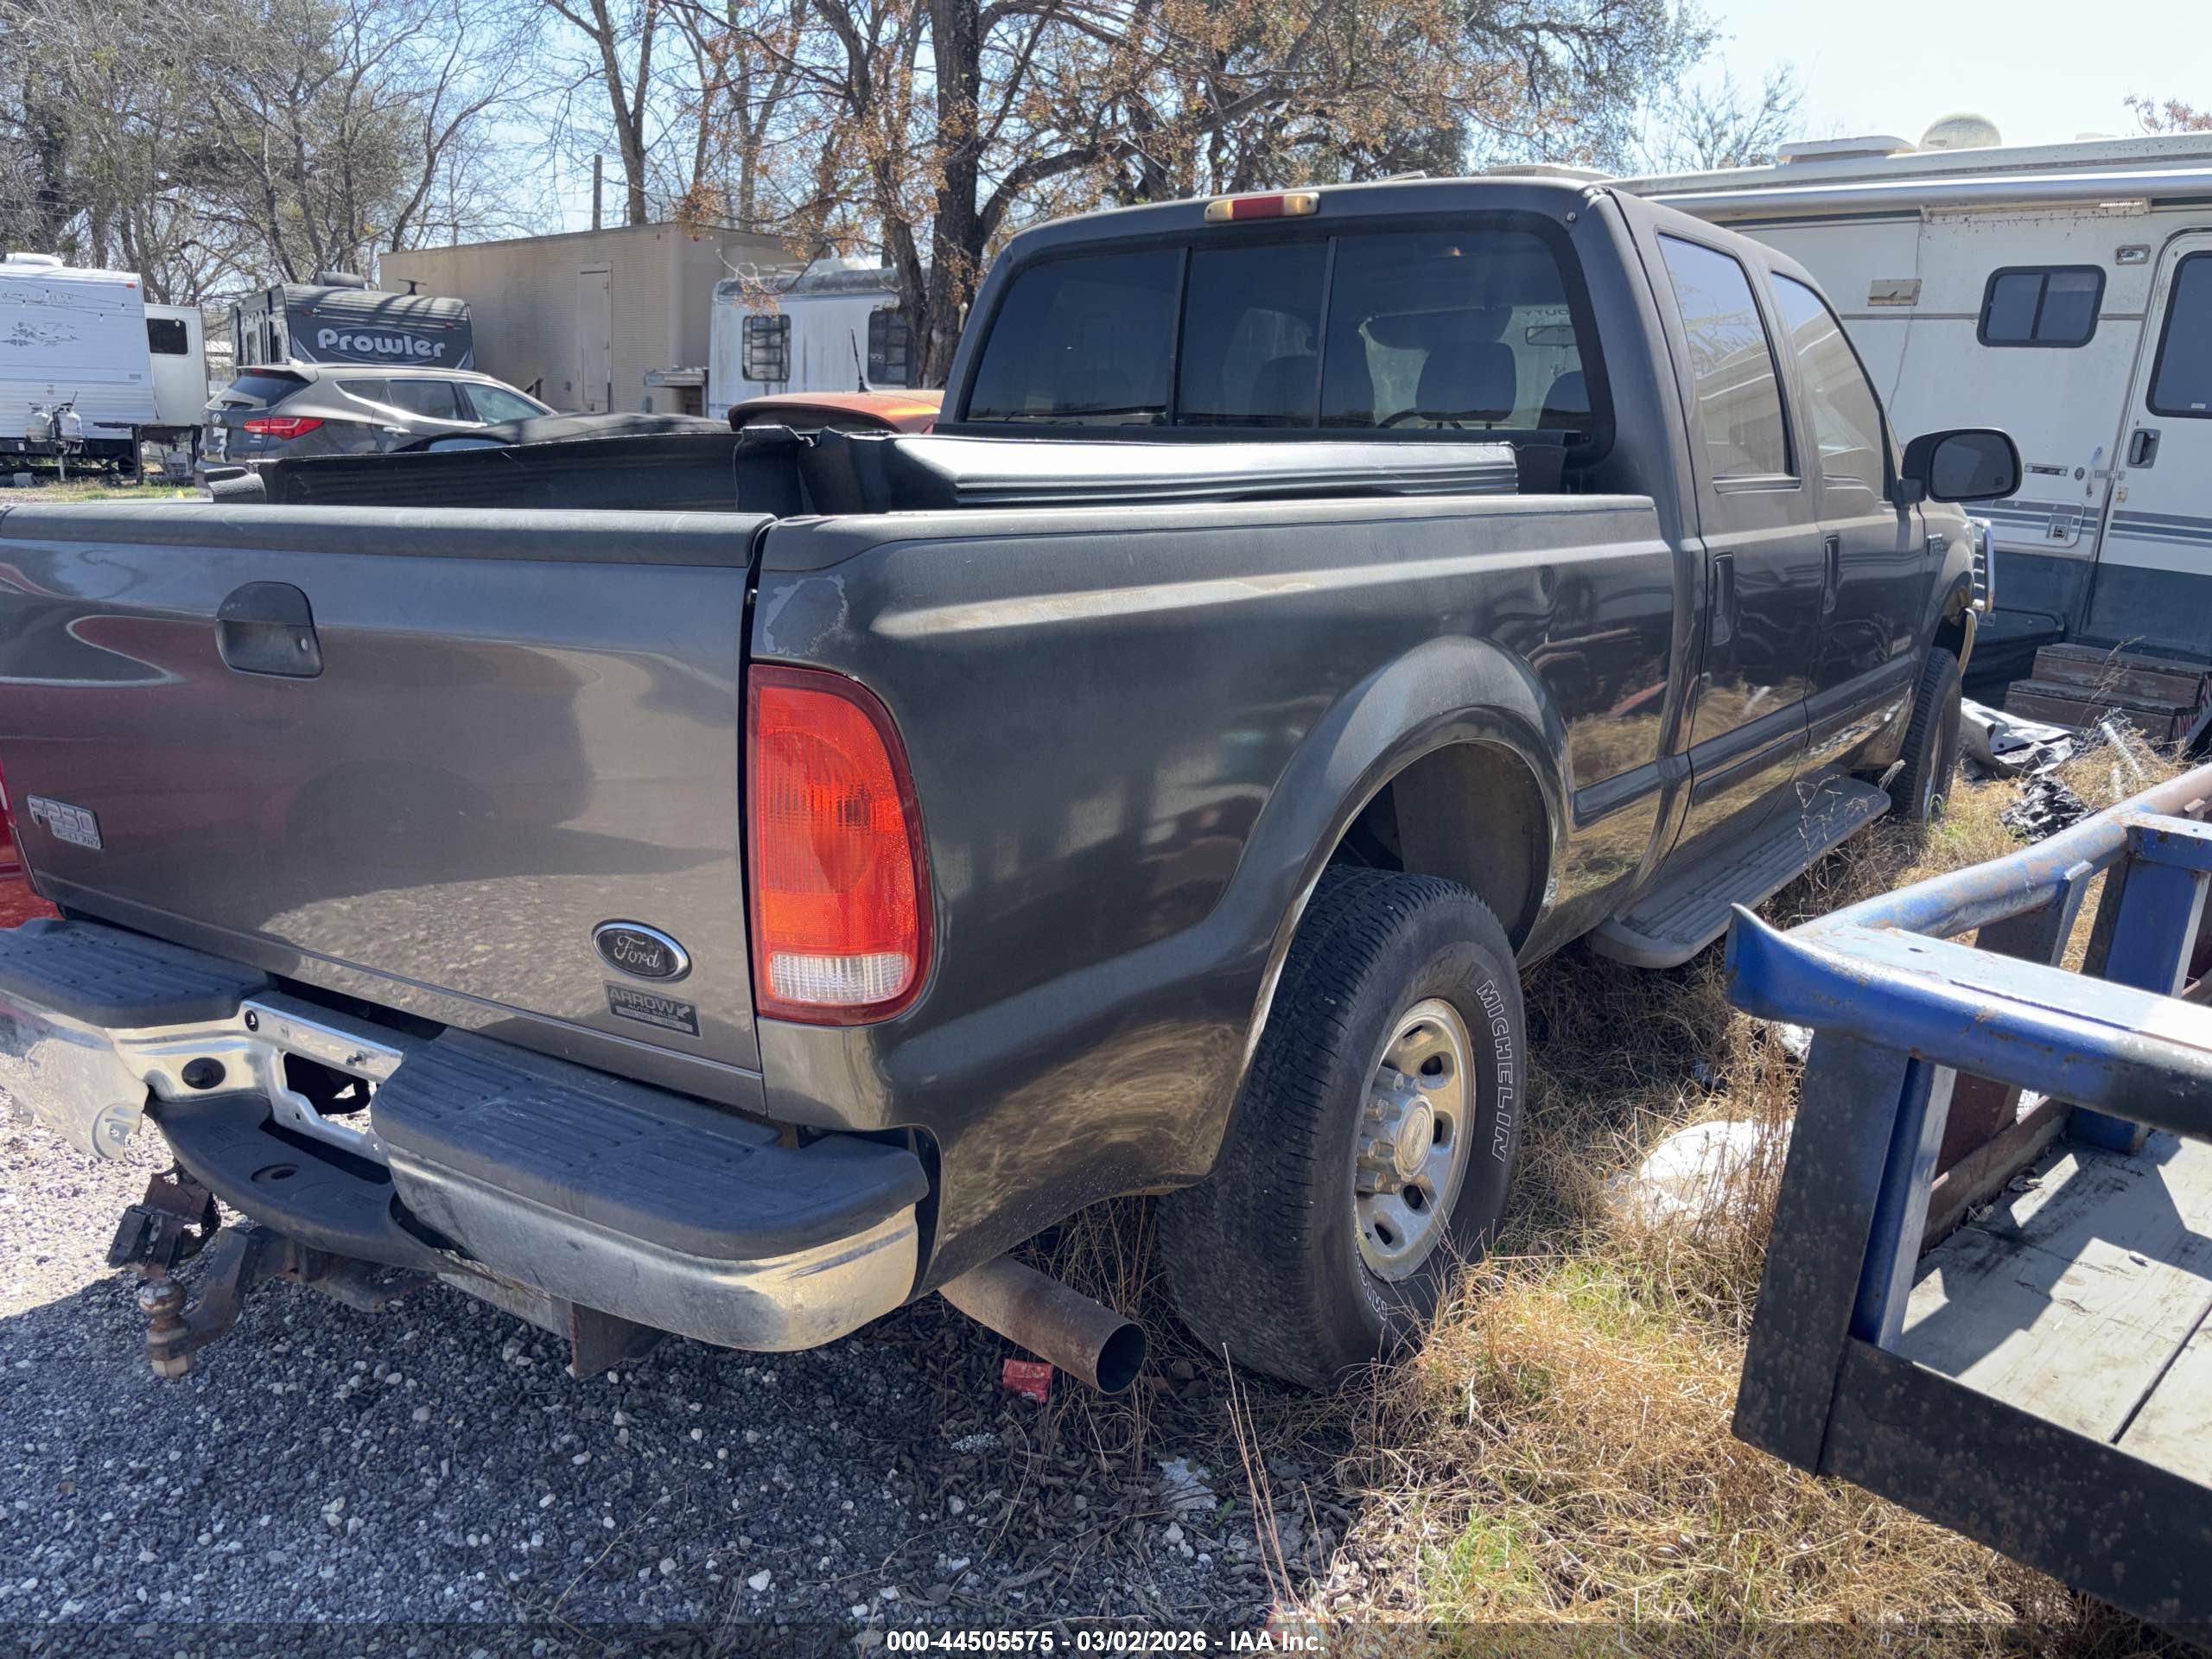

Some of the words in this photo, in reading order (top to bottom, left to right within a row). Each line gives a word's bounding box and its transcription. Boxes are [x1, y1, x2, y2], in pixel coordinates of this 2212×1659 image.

[317, 328, 445, 358] Prowler
[613, 935, 660, 969] Ford
[610, 988, 675, 1014] ARROW
[627, 1004, 650, 1014] AUTO
[652, 1010, 679, 1020] SALES
[1476, 979, 1514, 1162] MICHELIN
